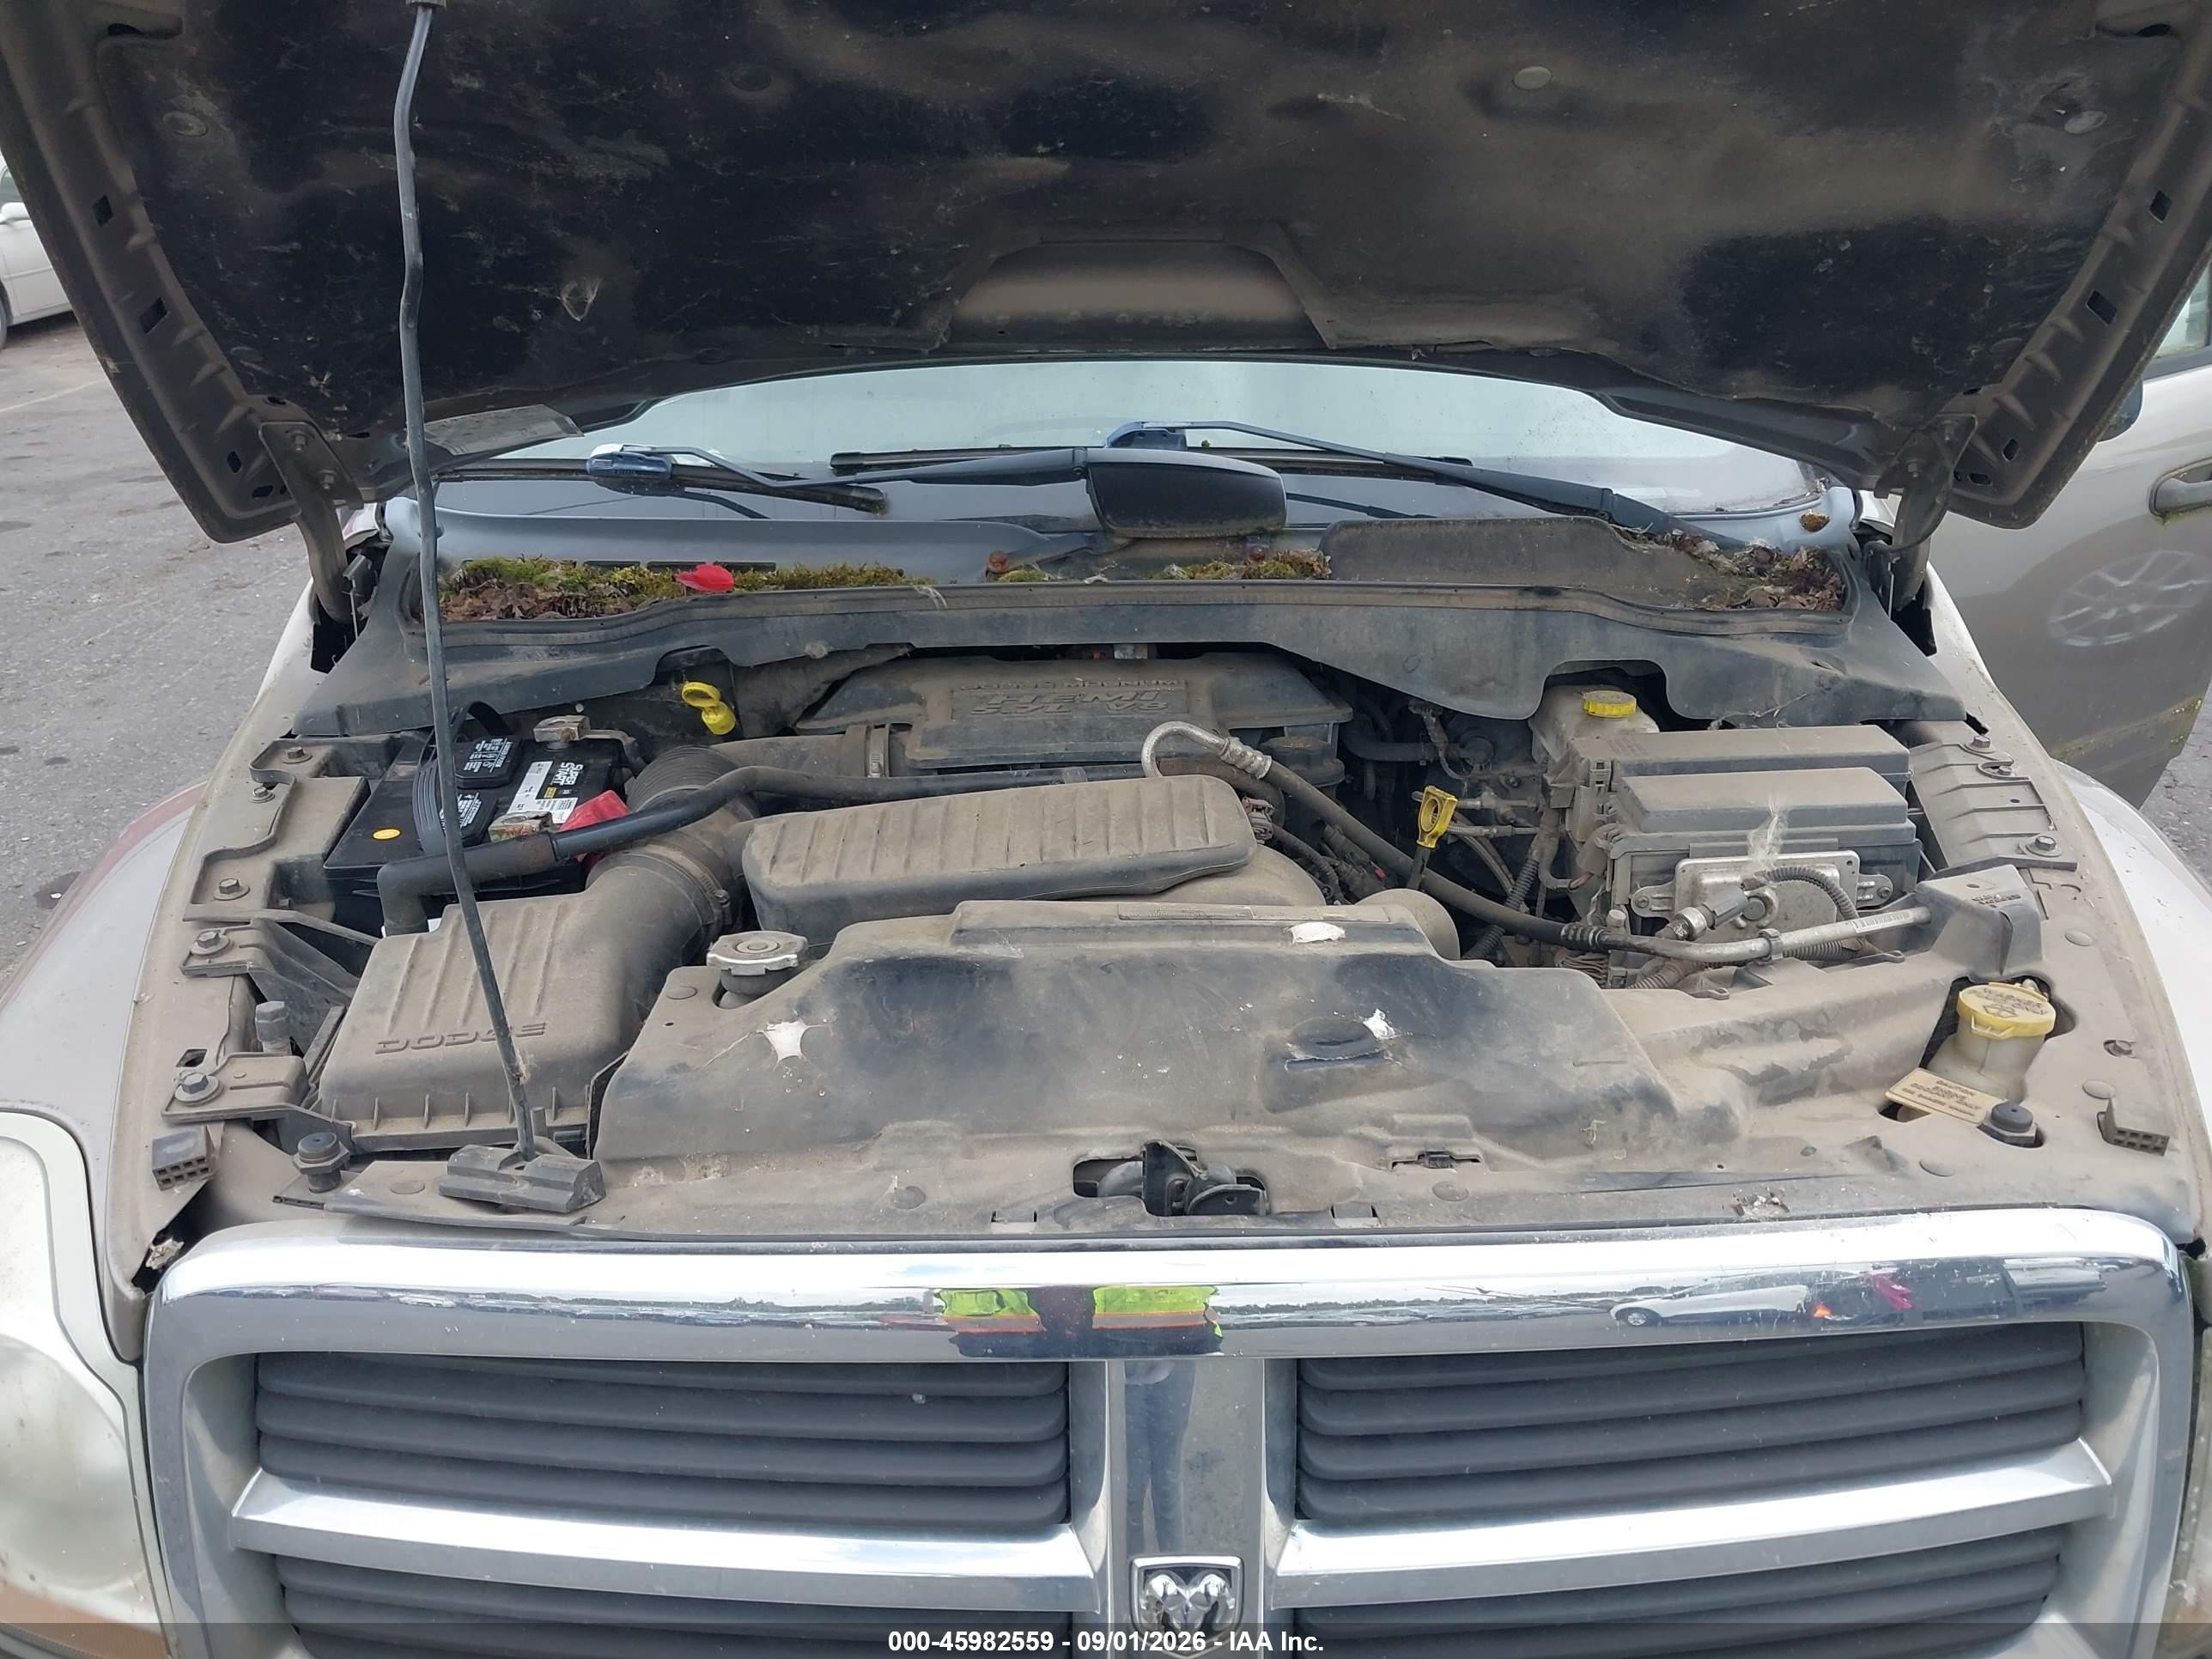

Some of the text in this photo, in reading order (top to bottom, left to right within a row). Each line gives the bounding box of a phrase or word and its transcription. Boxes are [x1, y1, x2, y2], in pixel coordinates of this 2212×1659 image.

[985, 690, 1160, 706] HEMI
[969, 702, 1169, 715] 5.7L V8
[552, 762, 574, 786] START
[563, 763, 584, 786] SUPER
